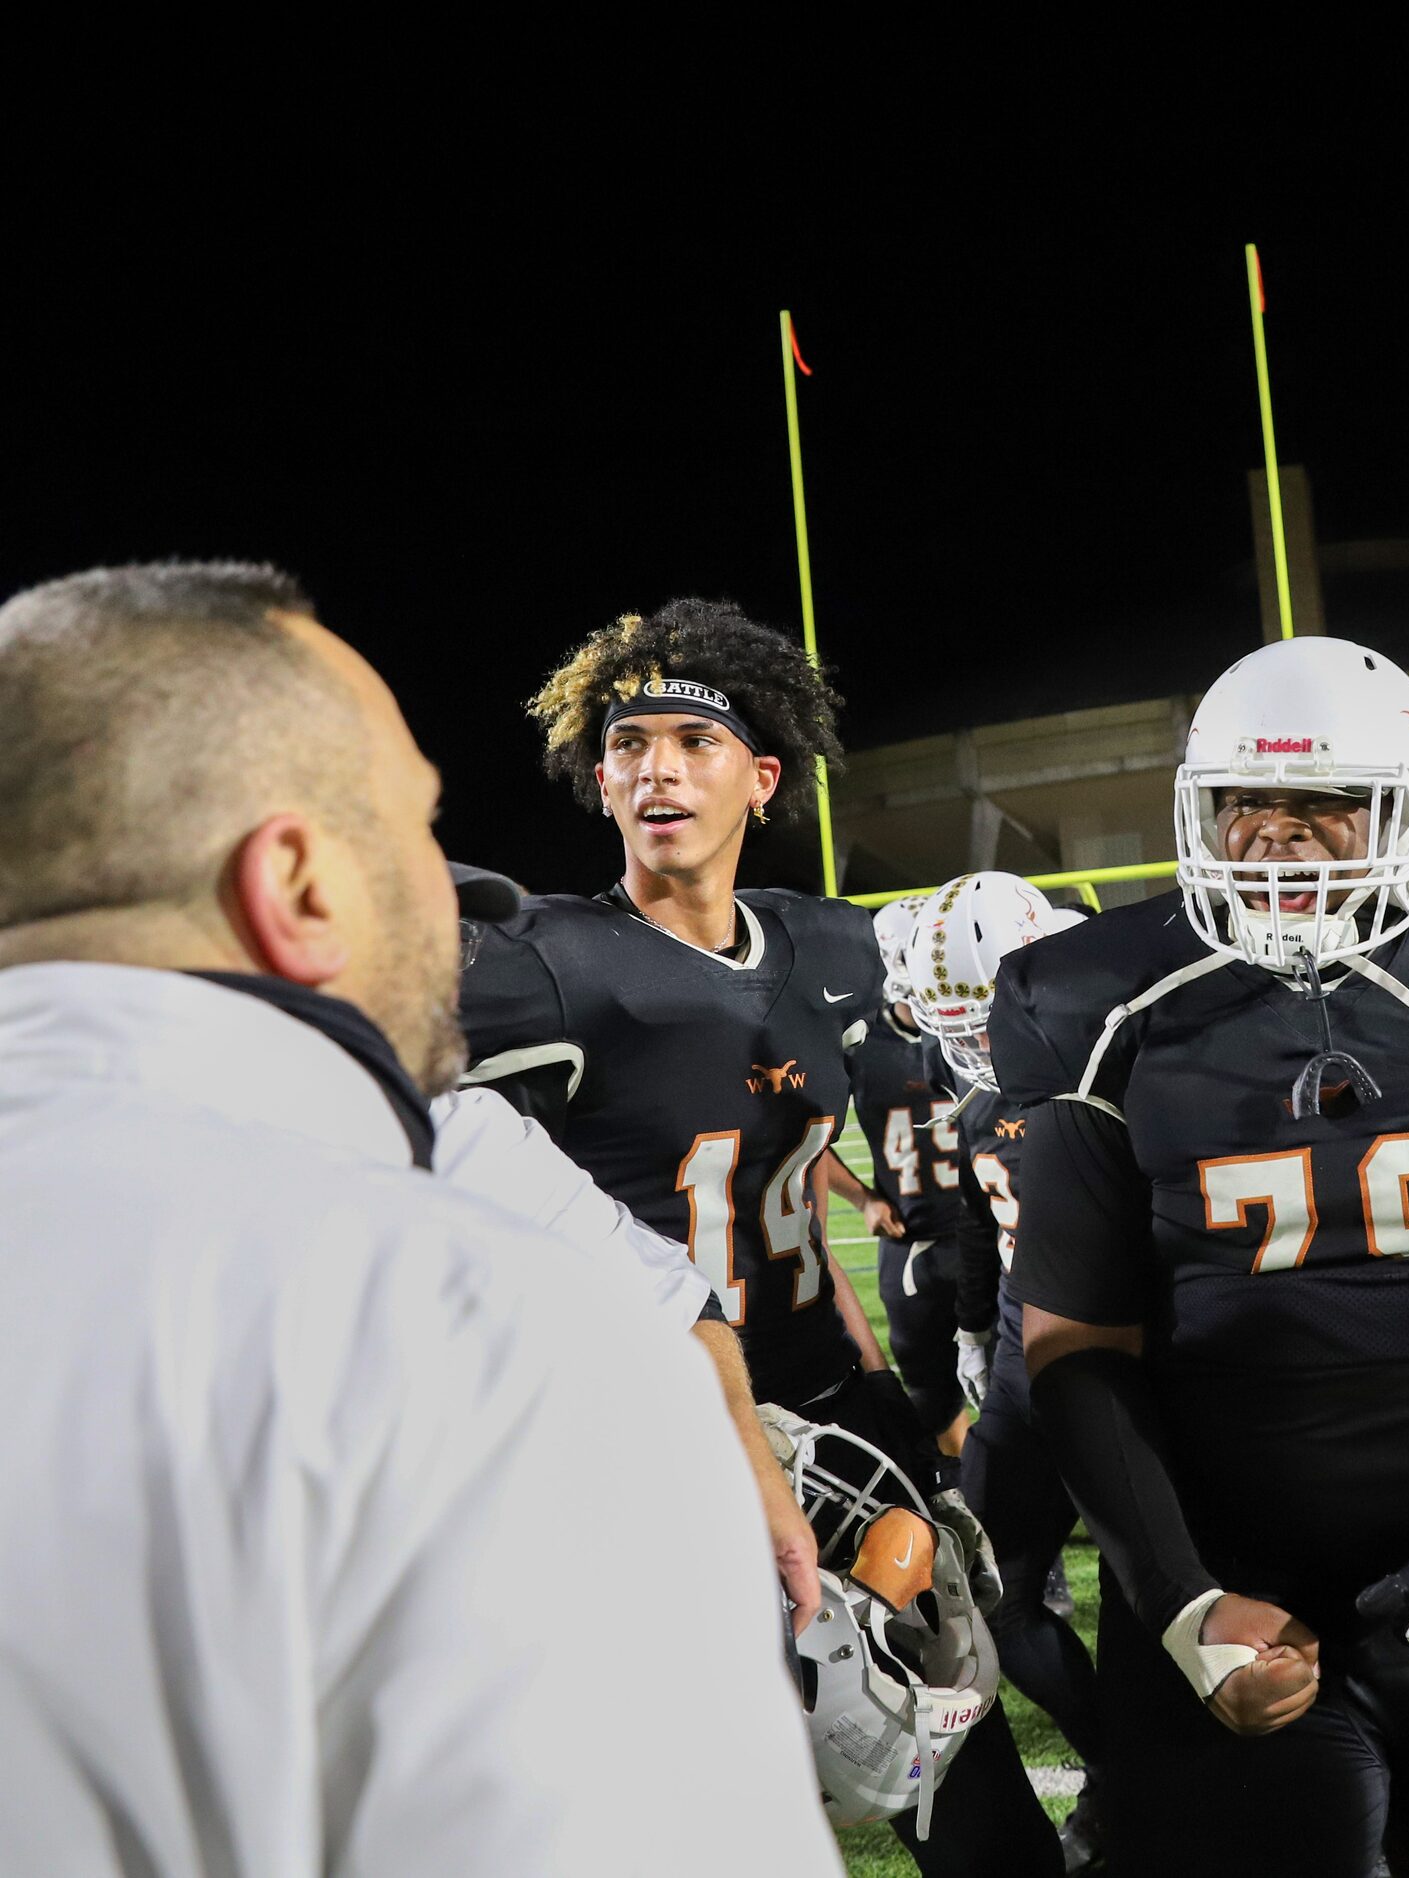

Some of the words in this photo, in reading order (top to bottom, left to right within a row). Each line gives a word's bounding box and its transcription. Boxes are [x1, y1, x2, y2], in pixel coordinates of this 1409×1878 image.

[1256, 738, 1312, 753] Riddell
[1265, 932, 1304, 943] Rdell
[674, 1115, 837, 1328] 14
